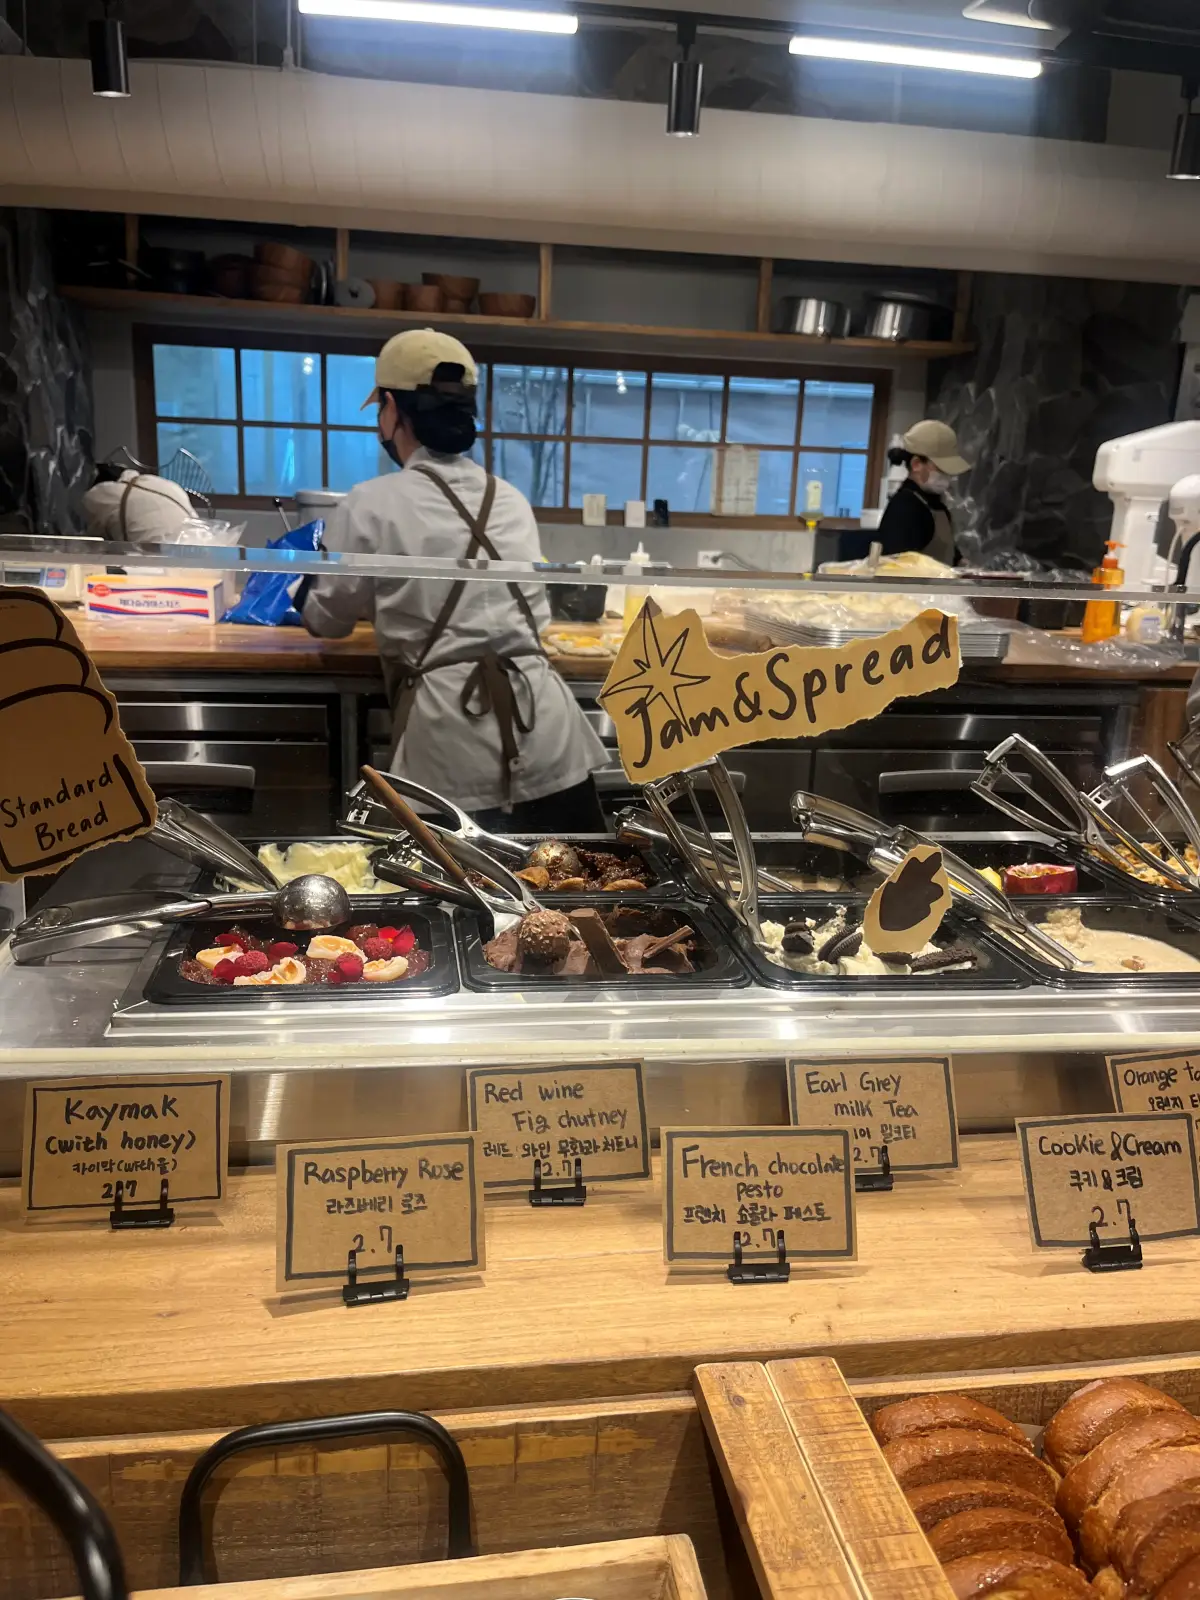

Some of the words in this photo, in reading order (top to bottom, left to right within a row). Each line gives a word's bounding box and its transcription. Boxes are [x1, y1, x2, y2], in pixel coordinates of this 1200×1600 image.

[0, 762, 113, 828] Standard
[35, 800, 108, 851] Bread
[805, 1071, 847, 1094] Earl
[859, 1071, 901, 1096] Grey
[1124, 1067, 1178, 1091] Orange
[484, 1080, 523, 1104] Red
[538, 1080, 584, 1101] wine
[1148, 1095, 1184, 1112] 오렌지
[65, 1095, 178, 1131] Kaymak
[512, 1110, 551, 1135] Fig
[558, 1107, 628, 1130] chutney
[834, 1100, 873, 1118] milk
[883, 1100, 918, 1118] Tea
[45, 1132, 107, 1155] (with
[120, 1130, 196, 1154] honey)
[880, 1123, 917, 1144] 밀크티
[1039, 1133, 1106, 1155] Cookie
[482, 1141, 513, 1157] 레드
[521, 1140, 550, 1159] 와인
[682, 1144, 759, 1178] French
[768, 1152, 845, 1175] chocolate
[304, 1159, 408, 1190] Raspberry
[418, 1158, 464, 1180] Rose
[542, 1159, 572, 1177] 2.7
[101, 1180, 138, 1199] 27
[326, 1195, 393, 1214] 라즈베리
[401, 1193, 428, 1215] 로즈
[683, 1204, 726, 1225] 프렌치
[737, 1202, 778, 1226] 쇼콜라
[784, 1202, 832, 1221] 페스토
[1091, 1199, 1133, 1228] 2.7
[352, 1225, 393, 1253] 2.7
[740, 1228, 776, 1248] 2.7
